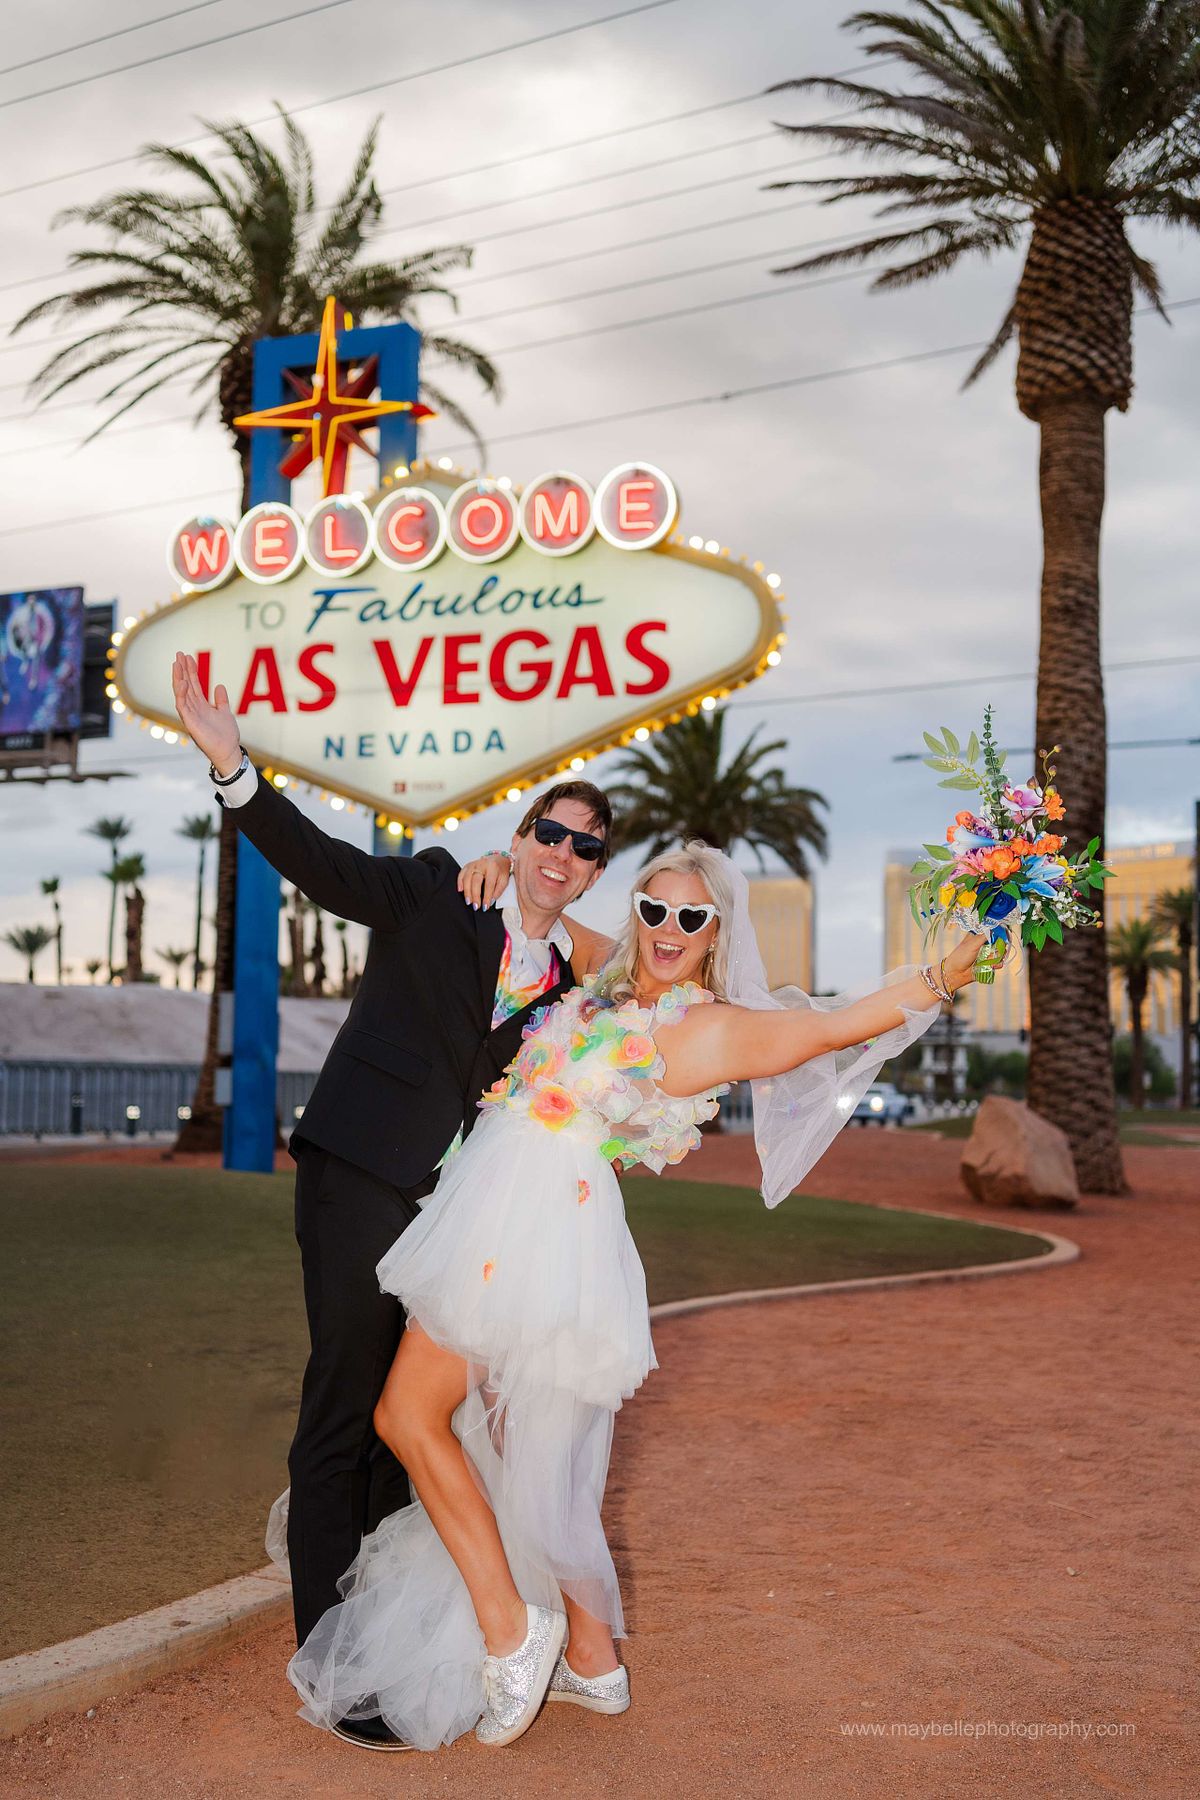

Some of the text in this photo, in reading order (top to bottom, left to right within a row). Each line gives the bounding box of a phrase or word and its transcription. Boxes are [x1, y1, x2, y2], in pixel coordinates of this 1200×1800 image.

[179, 480, 656, 577] WELCOME
[241, 576, 604, 634] TO Fabulous
[373, 621, 671, 708] VEGAS
[324, 729, 505, 759] NEVADA
